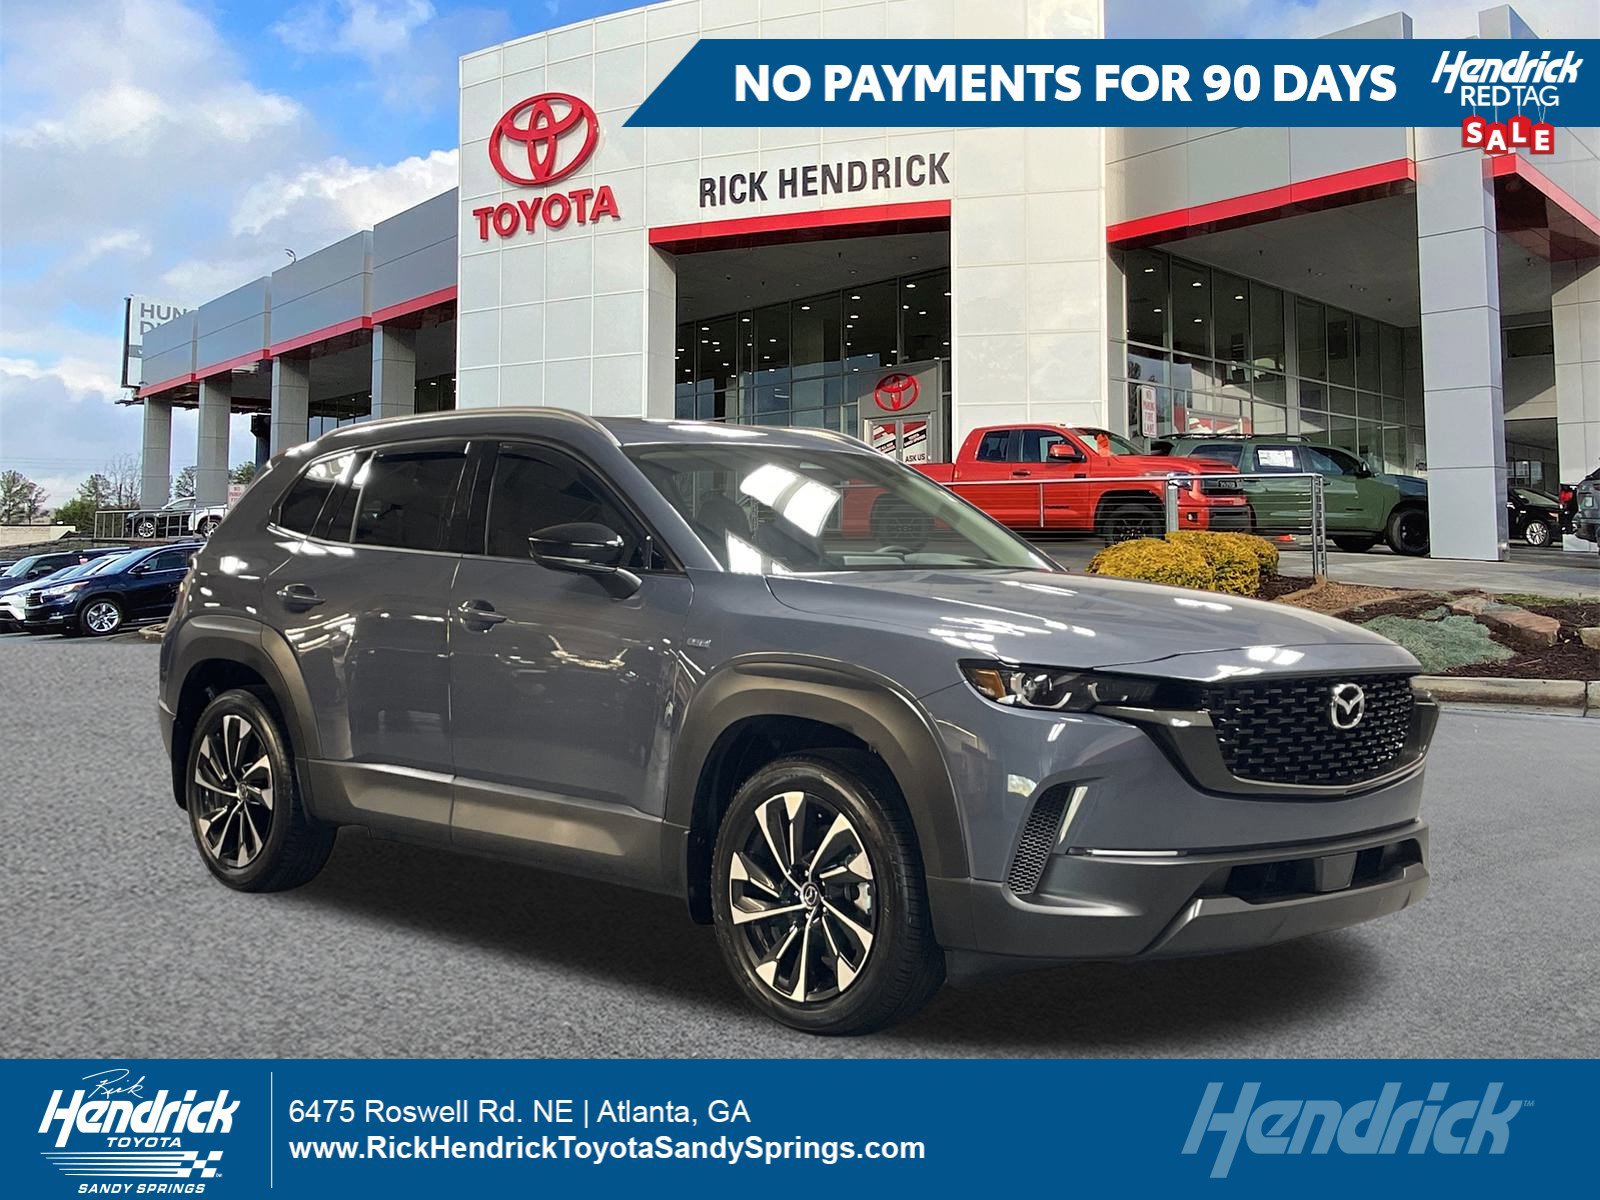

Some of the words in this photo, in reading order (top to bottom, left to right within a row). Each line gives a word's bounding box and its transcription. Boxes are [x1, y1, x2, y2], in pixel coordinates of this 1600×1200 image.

[699, 170, 768, 208] RICK
[778, 152, 950, 199] HENDRICK
[472, 185, 621, 240] TOYOTA
[905, 454, 917, 463] ASK
[917, 453, 926, 461] US
